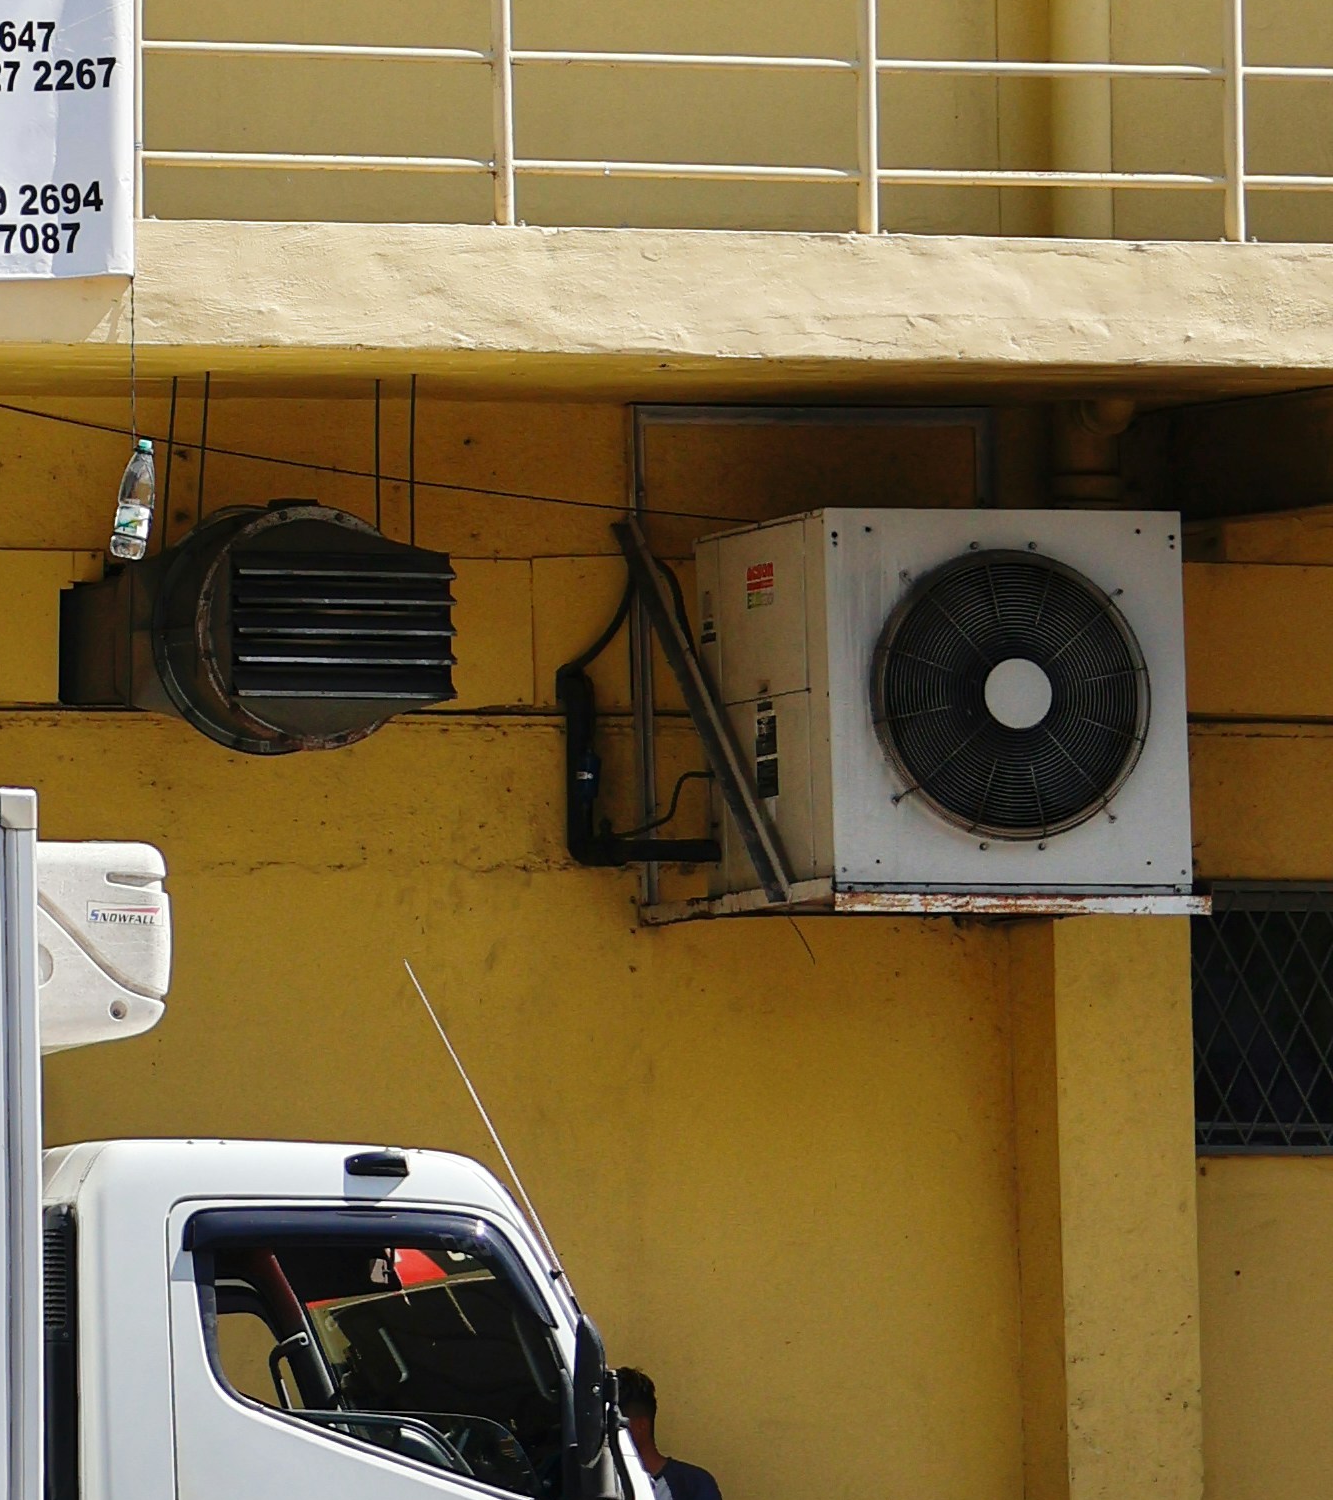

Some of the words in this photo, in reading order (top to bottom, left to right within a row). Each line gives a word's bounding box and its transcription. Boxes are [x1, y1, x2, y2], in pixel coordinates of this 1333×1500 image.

[32, 56, 117, 92] 2267
[18, 180, 104, 216] 2694
[89, 909, 155, 925] SNOWFALL
